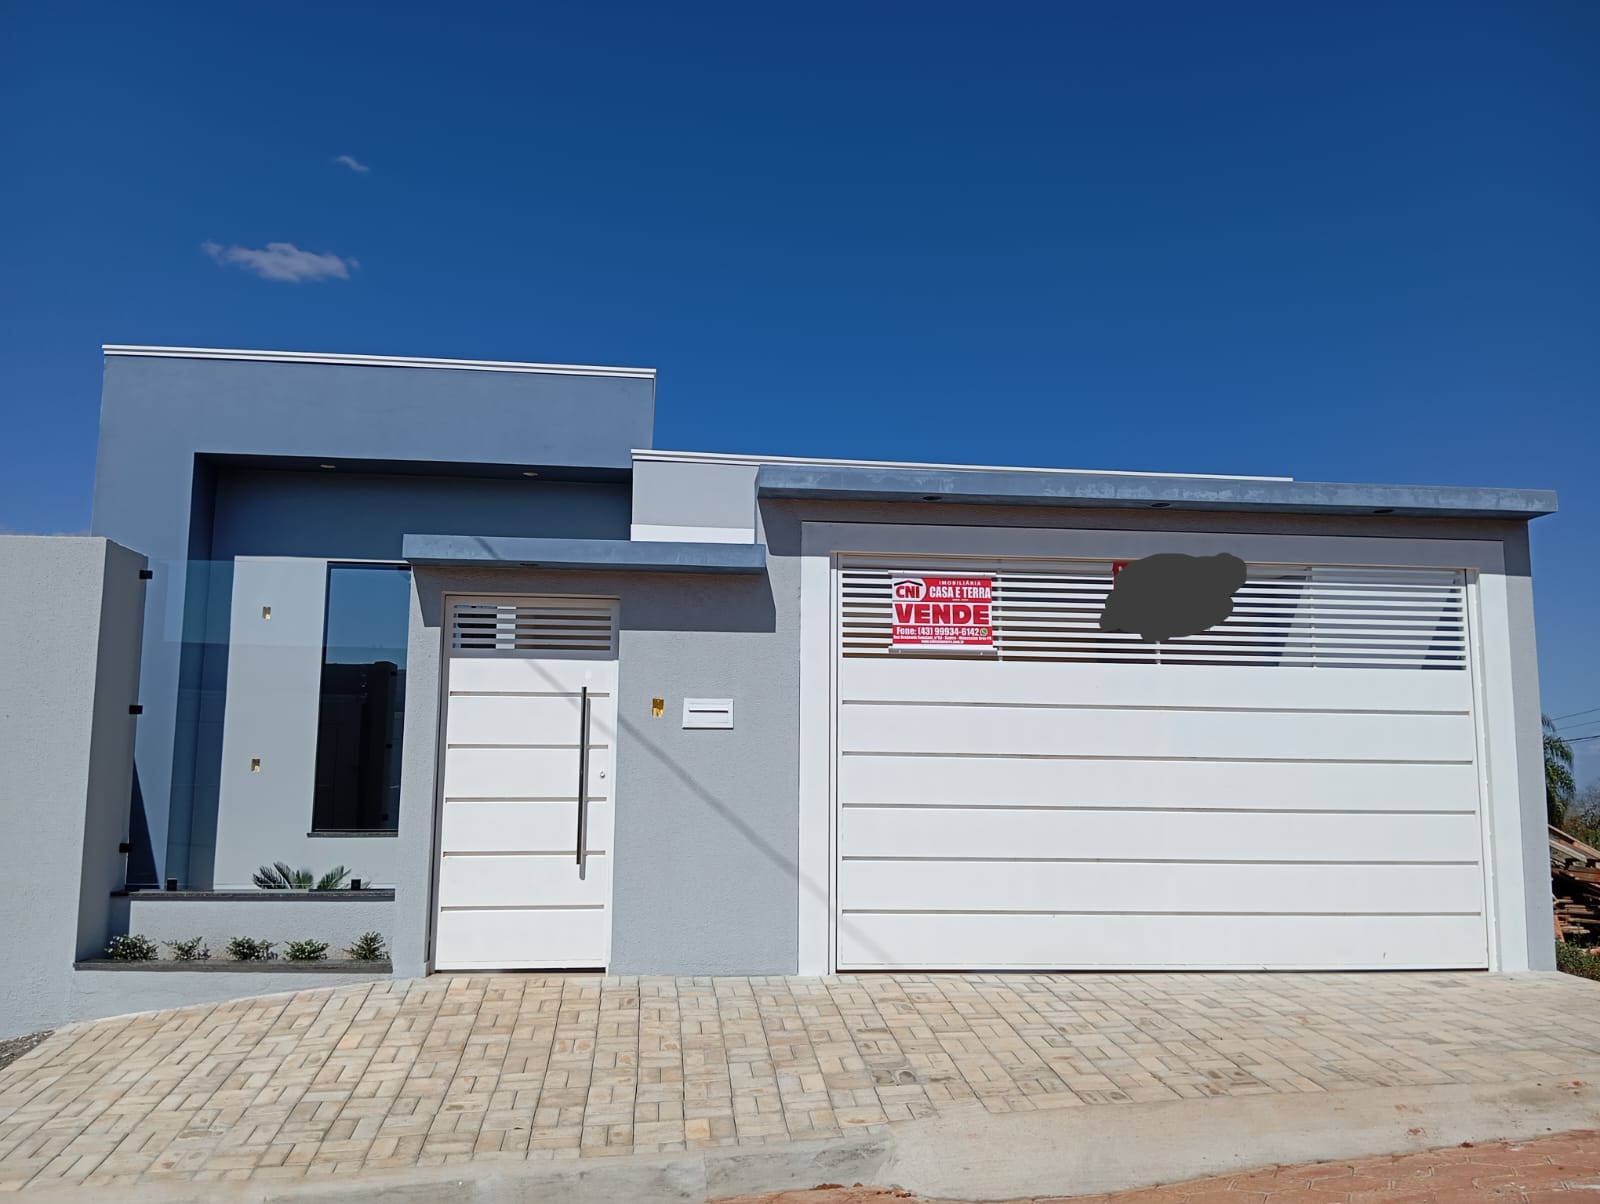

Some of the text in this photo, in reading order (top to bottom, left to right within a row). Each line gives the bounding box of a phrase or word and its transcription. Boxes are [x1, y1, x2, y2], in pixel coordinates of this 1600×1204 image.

[895, 585, 921, 599] CNI
[929, 586, 991, 599] CASA E TERRA
[894, 603, 990, 625] VENDE
[896, 627, 979, 636] Fone: (43) 99934-6142
